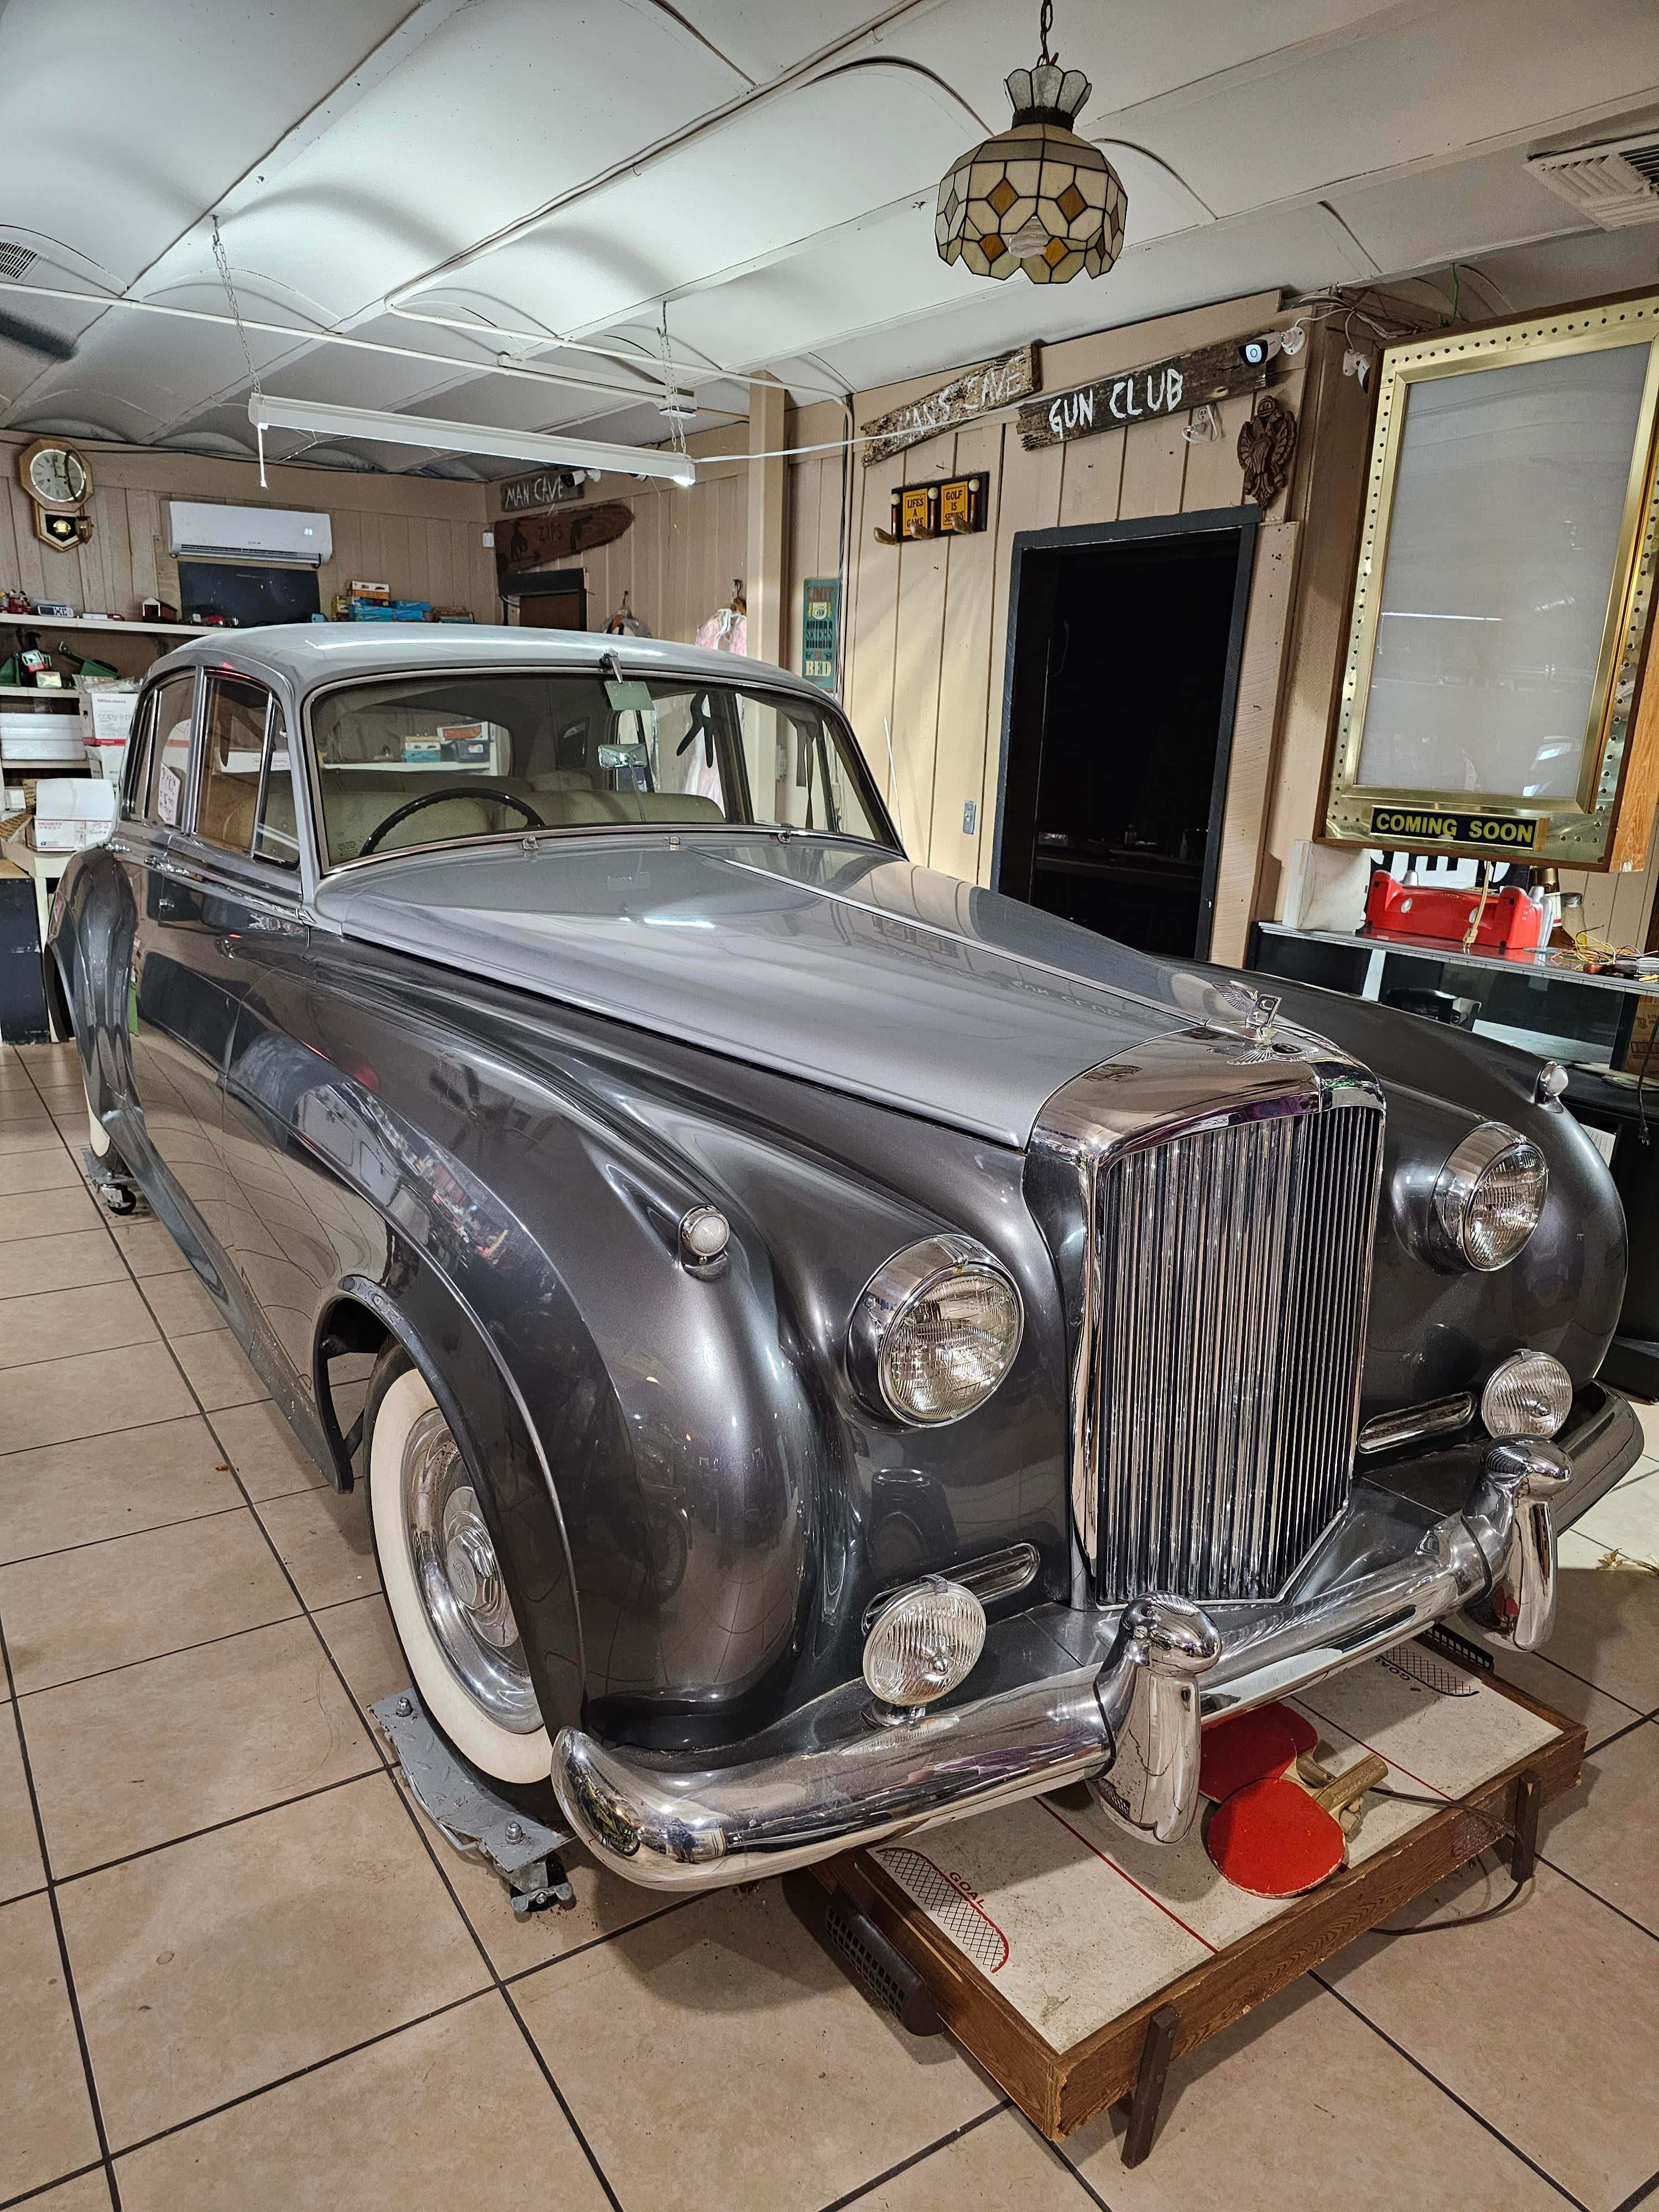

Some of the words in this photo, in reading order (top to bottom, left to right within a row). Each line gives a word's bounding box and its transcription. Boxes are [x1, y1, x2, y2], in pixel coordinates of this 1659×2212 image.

[1049, 388, 1093, 439] GUN
[1109, 368, 1183, 419] CLUB
[505, 483, 530, 508] MAN
[534, 475, 564, 503] CAVE
[907, 495, 924, 509] LIFE'S
[946, 489, 963, 500] GOLF
[913, 508, 917, 517] A
[951, 502, 957, 511] IS
[812, 602, 827, 620] 5
[806, 620, 833, 649] SKIERS
[805, 660, 832, 677] BED
[1376, 813, 1458, 837] COMING
[1468, 820, 1533, 843] SOON
[1375, 1655, 1411, 1681] GOAL
[950, 1871, 985, 1909] GOAL
